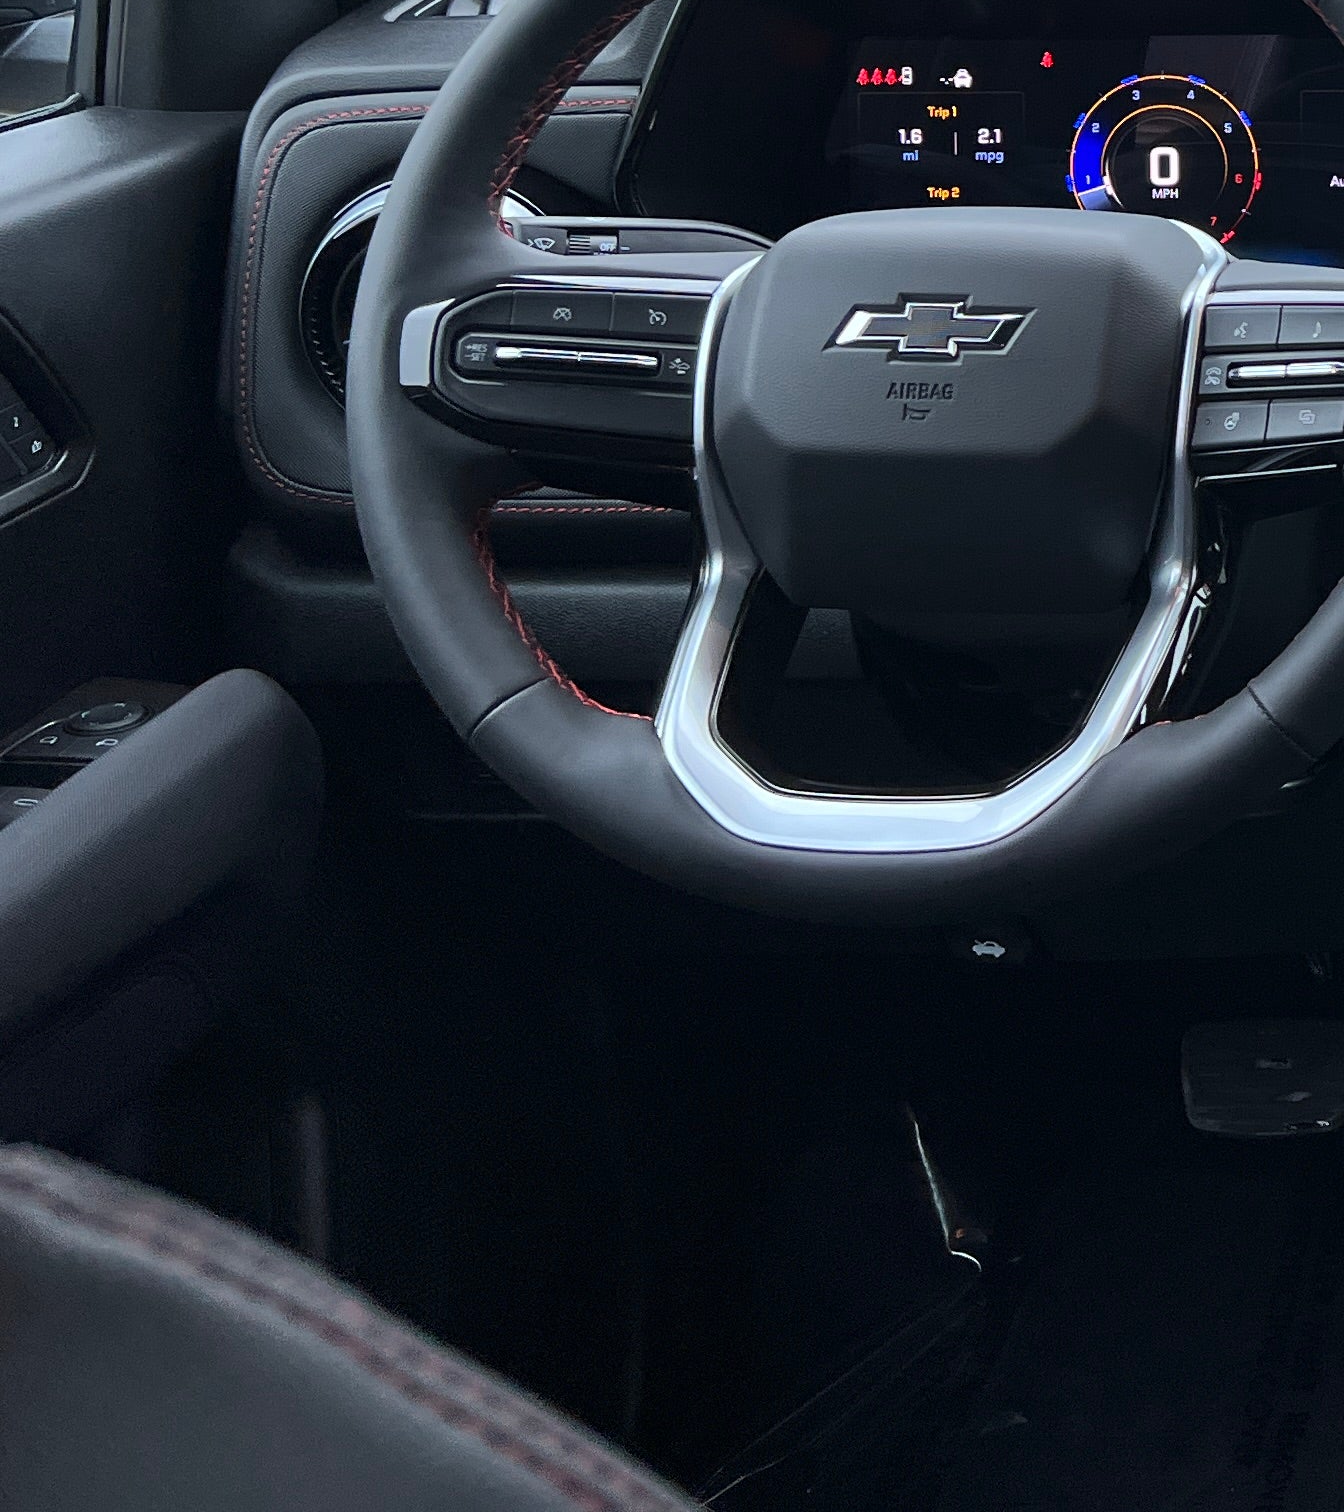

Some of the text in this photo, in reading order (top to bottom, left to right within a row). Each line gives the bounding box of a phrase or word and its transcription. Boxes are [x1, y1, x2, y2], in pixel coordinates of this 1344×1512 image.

[1132, 90, 1195, 100] 3 4
[927, 105, 957, 120] Trip 1
[1091, 122, 1232, 133] 2 5
[898, 128, 1002, 145] 1.6 2.1
[902, 150, 1004, 164] mi mpg
[1150, 146, 1180, 187] 0
[1084, 173, 1243, 185] 1 6
[927, 186, 960, 201] Trip 2
[1151, 188, 1179, 199] MPH
[1209, 216, 1217, 227] 7
[887, 382, 954, 400] AIRBAG
